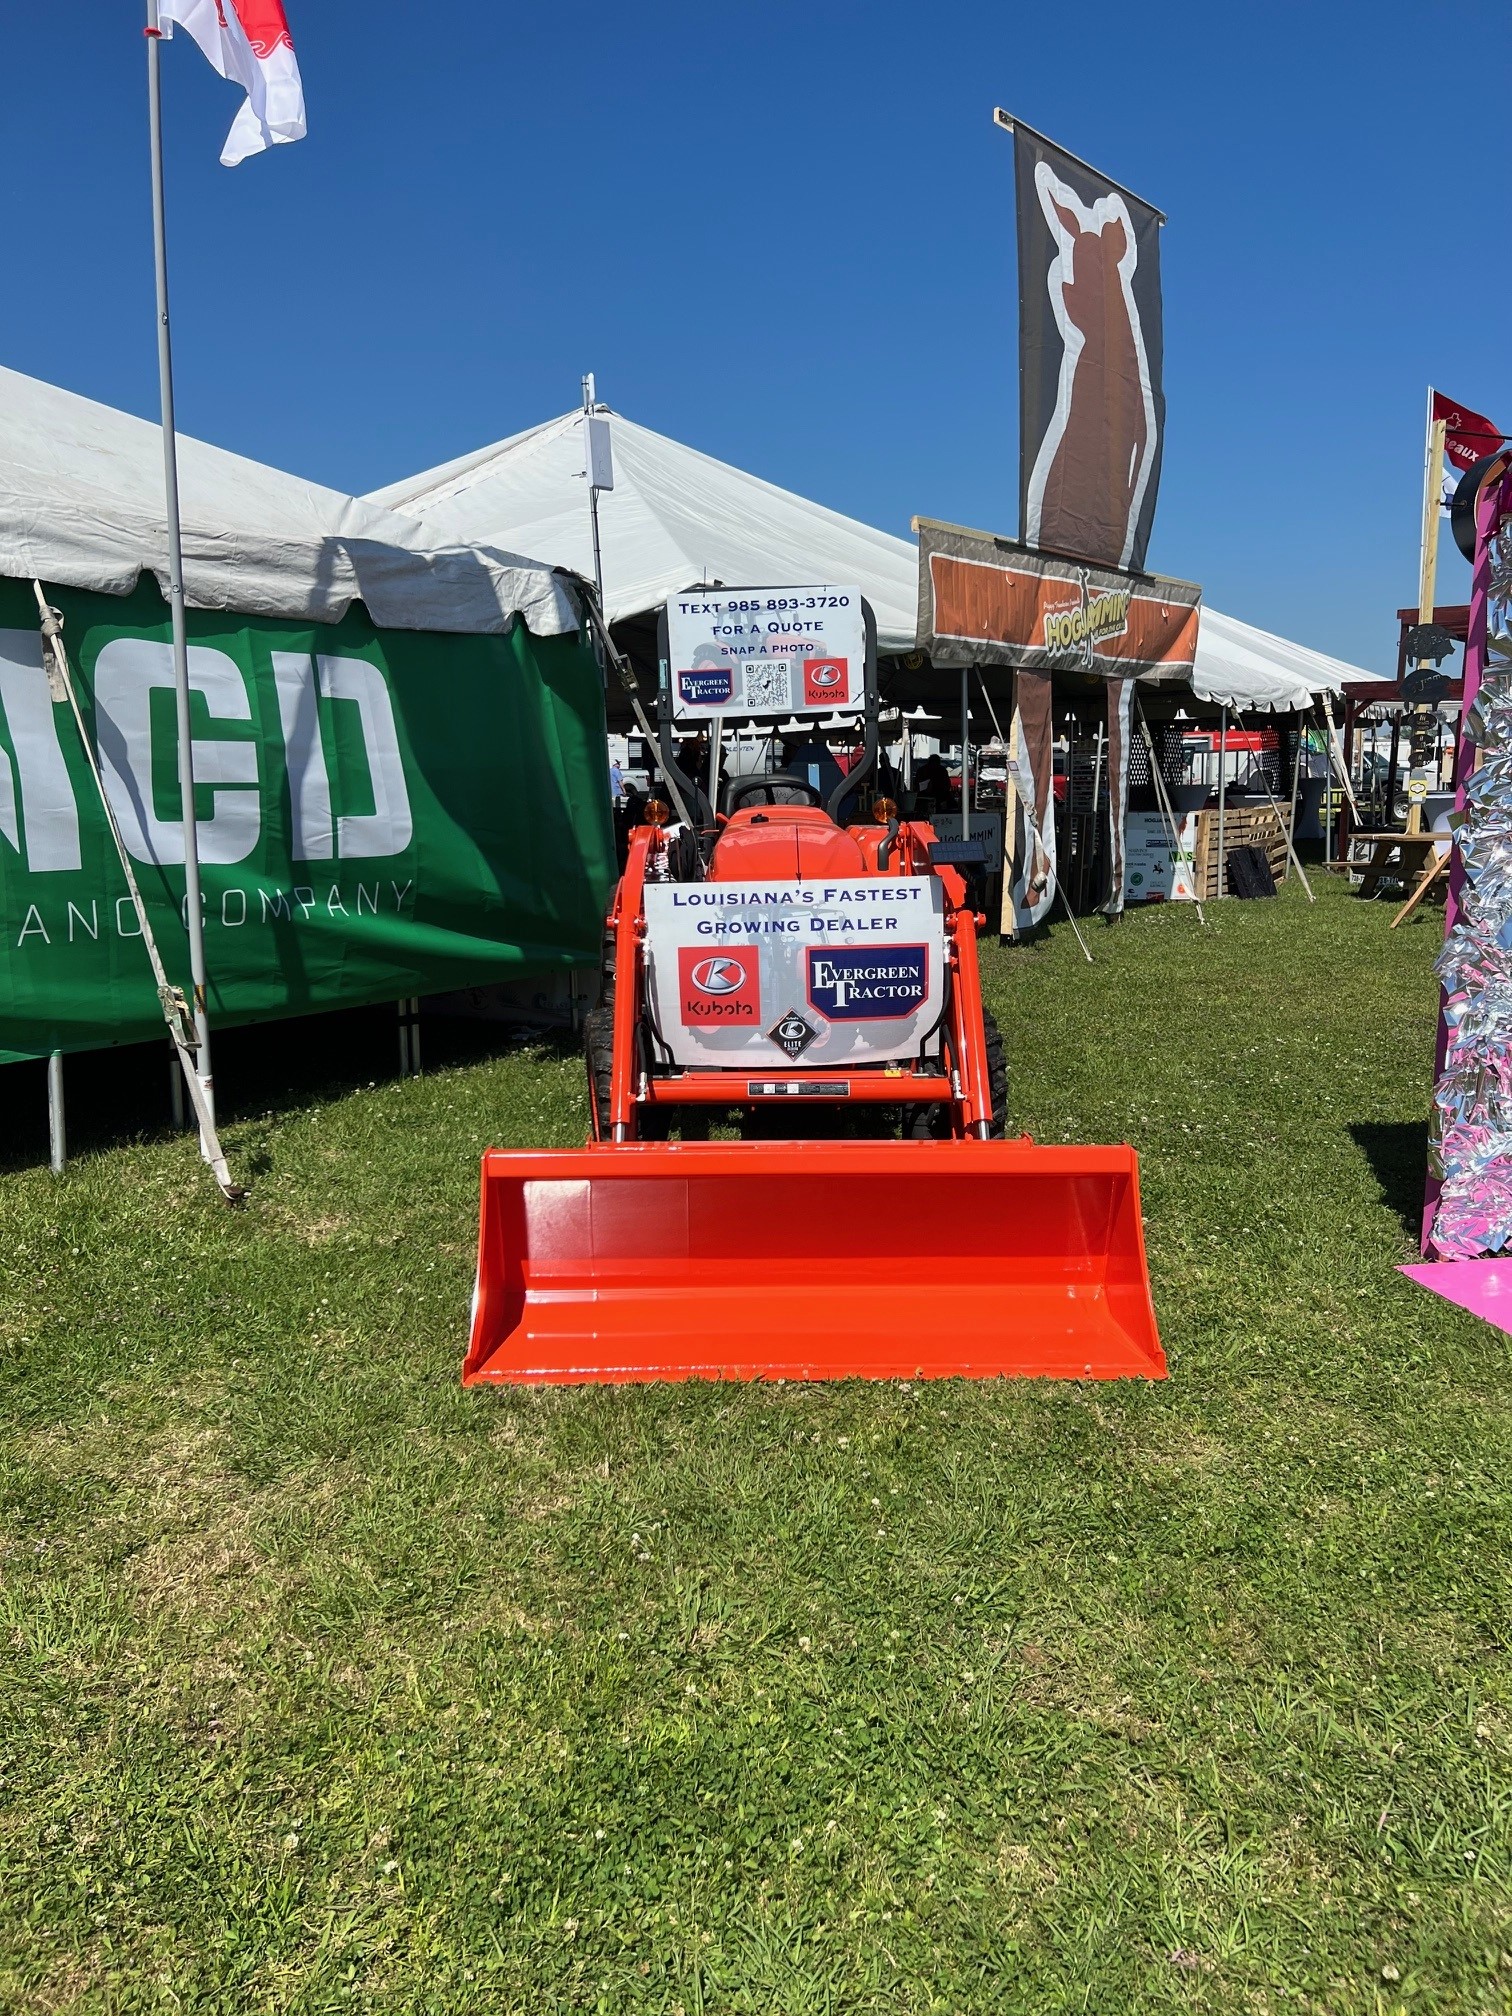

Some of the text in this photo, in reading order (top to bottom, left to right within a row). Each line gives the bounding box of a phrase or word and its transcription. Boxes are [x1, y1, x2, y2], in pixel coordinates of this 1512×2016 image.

[679, 596, 850, 615] TEXT 985 893-3720
[713, 621, 824, 636] FOR A QUOTE
[721, 643, 814, 656] SNAP A PHOTO
[681, 676, 729, 691] EVERGREEN
[689, 685, 731, 699] TRACTOR
[808, 689, 845, 699] Kubota
[182, 878, 413, 931] COMPANY
[673, 887, 922, 907] LOUISIANA'S FASTEST
[696, 917, 898, 935] GROWING DEALER
[812, 960, 920, 990] EVERGREEN
[826, 979, 923, 1008] TRACTOR
[688, 1000, 753, 1016] Kubota
[783, 1040, 802, 1048] ELITE
